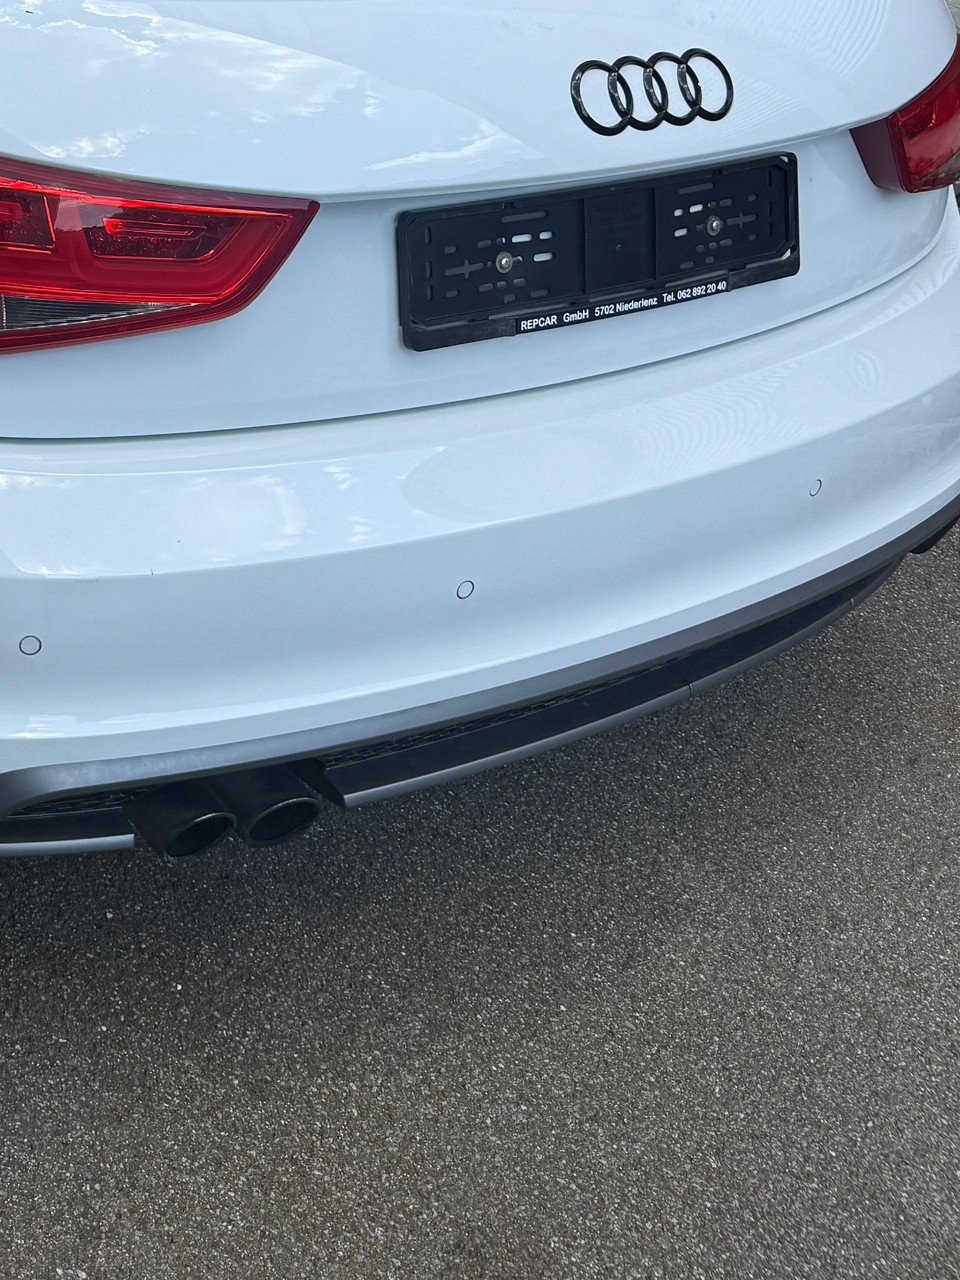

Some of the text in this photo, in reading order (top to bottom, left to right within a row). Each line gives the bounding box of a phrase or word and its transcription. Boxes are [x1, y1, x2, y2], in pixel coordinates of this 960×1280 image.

[521, 281, 727, 330] REPCAR GmbH 5702 Niederlenz Tel. 062 892 20 40
